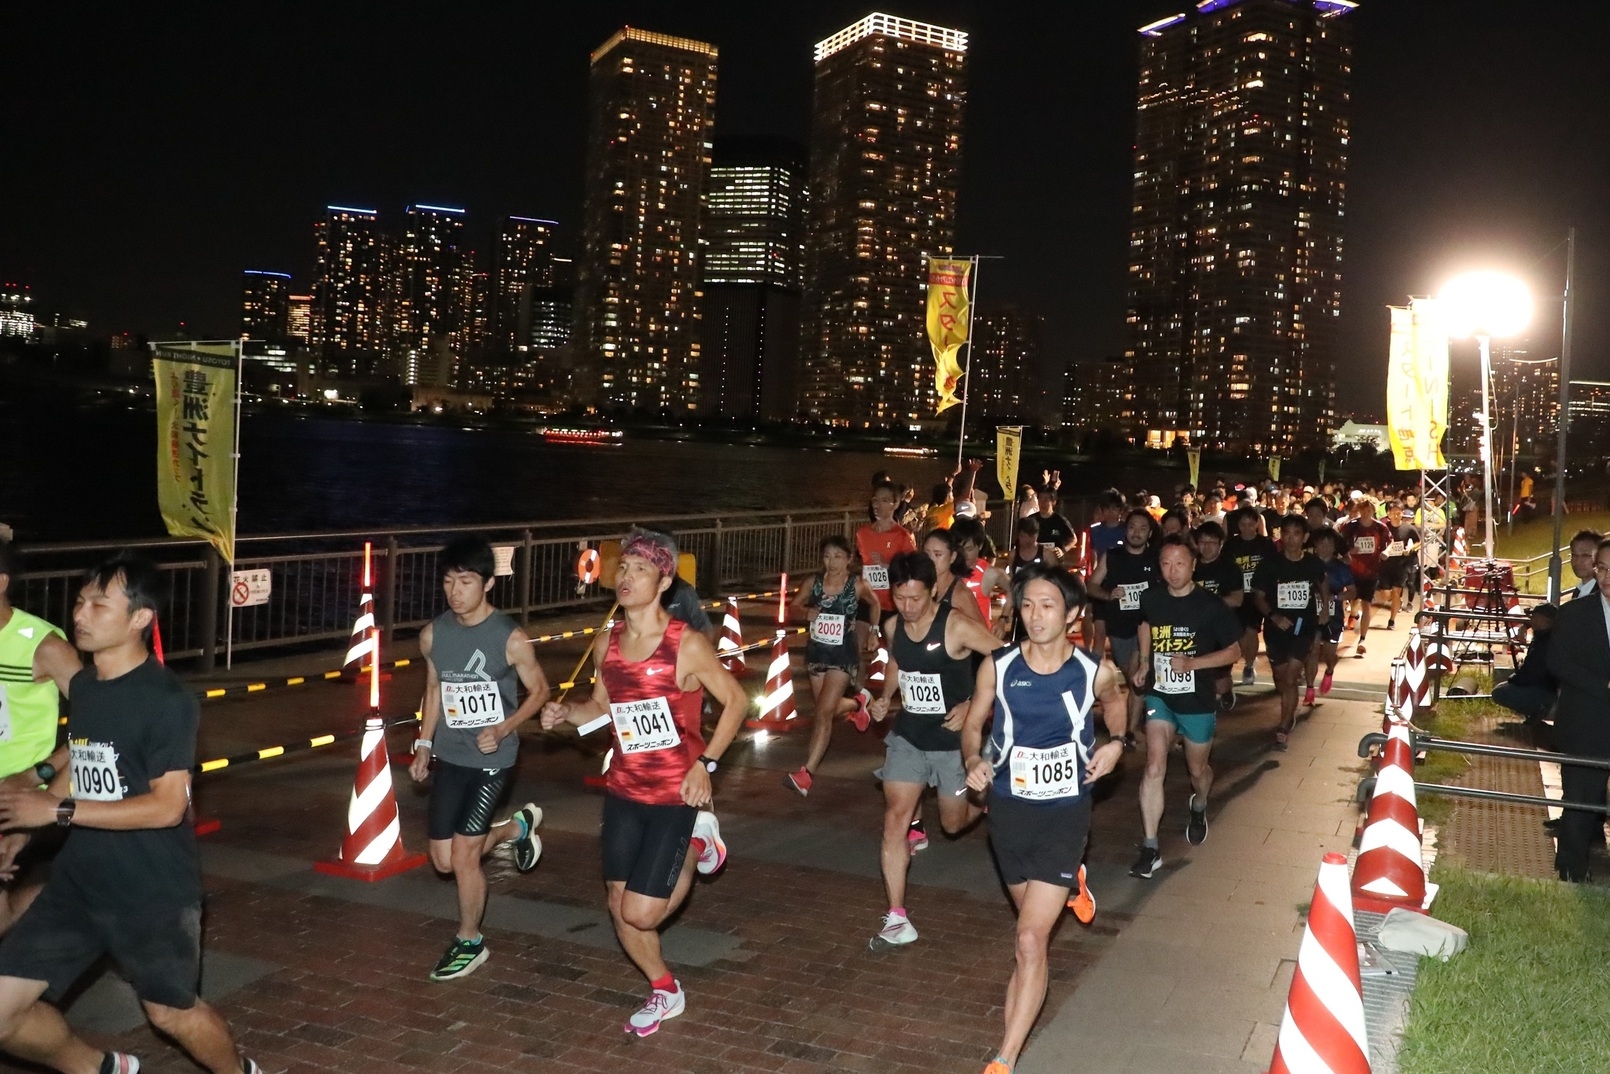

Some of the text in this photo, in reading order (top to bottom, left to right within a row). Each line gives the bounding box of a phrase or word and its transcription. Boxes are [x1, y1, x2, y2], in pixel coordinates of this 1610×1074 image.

[868, 571, 888, 582] 1026
[1129, 591, 1142, 602] 10
[1288, 590, 1308, 601] 1035
[818, 622, 842, 636] 2002
[907, 675, 935, 684] 大和輸送
[455, 684, 492, 694] 大和輸送
[910, 685, 941, 702] 1028
[460, 693, 497, 715] 1017
[625, 701, 661, 714] 大和輸送
[451, 716, 499, 726] スポーツニッポン
[632, 712, 670, 736] 1041
[627, 738, 674, 751] スポーツニッポン
[71, 748, 106, 763] 大和輸送
[1029, 747, 1069, 762] 大和輸送
[1032, 759, 1074, 785] 1085
[75, 764, 115, 794] 1090
[1017, 786, 1072, 798] スポーツニッポン
